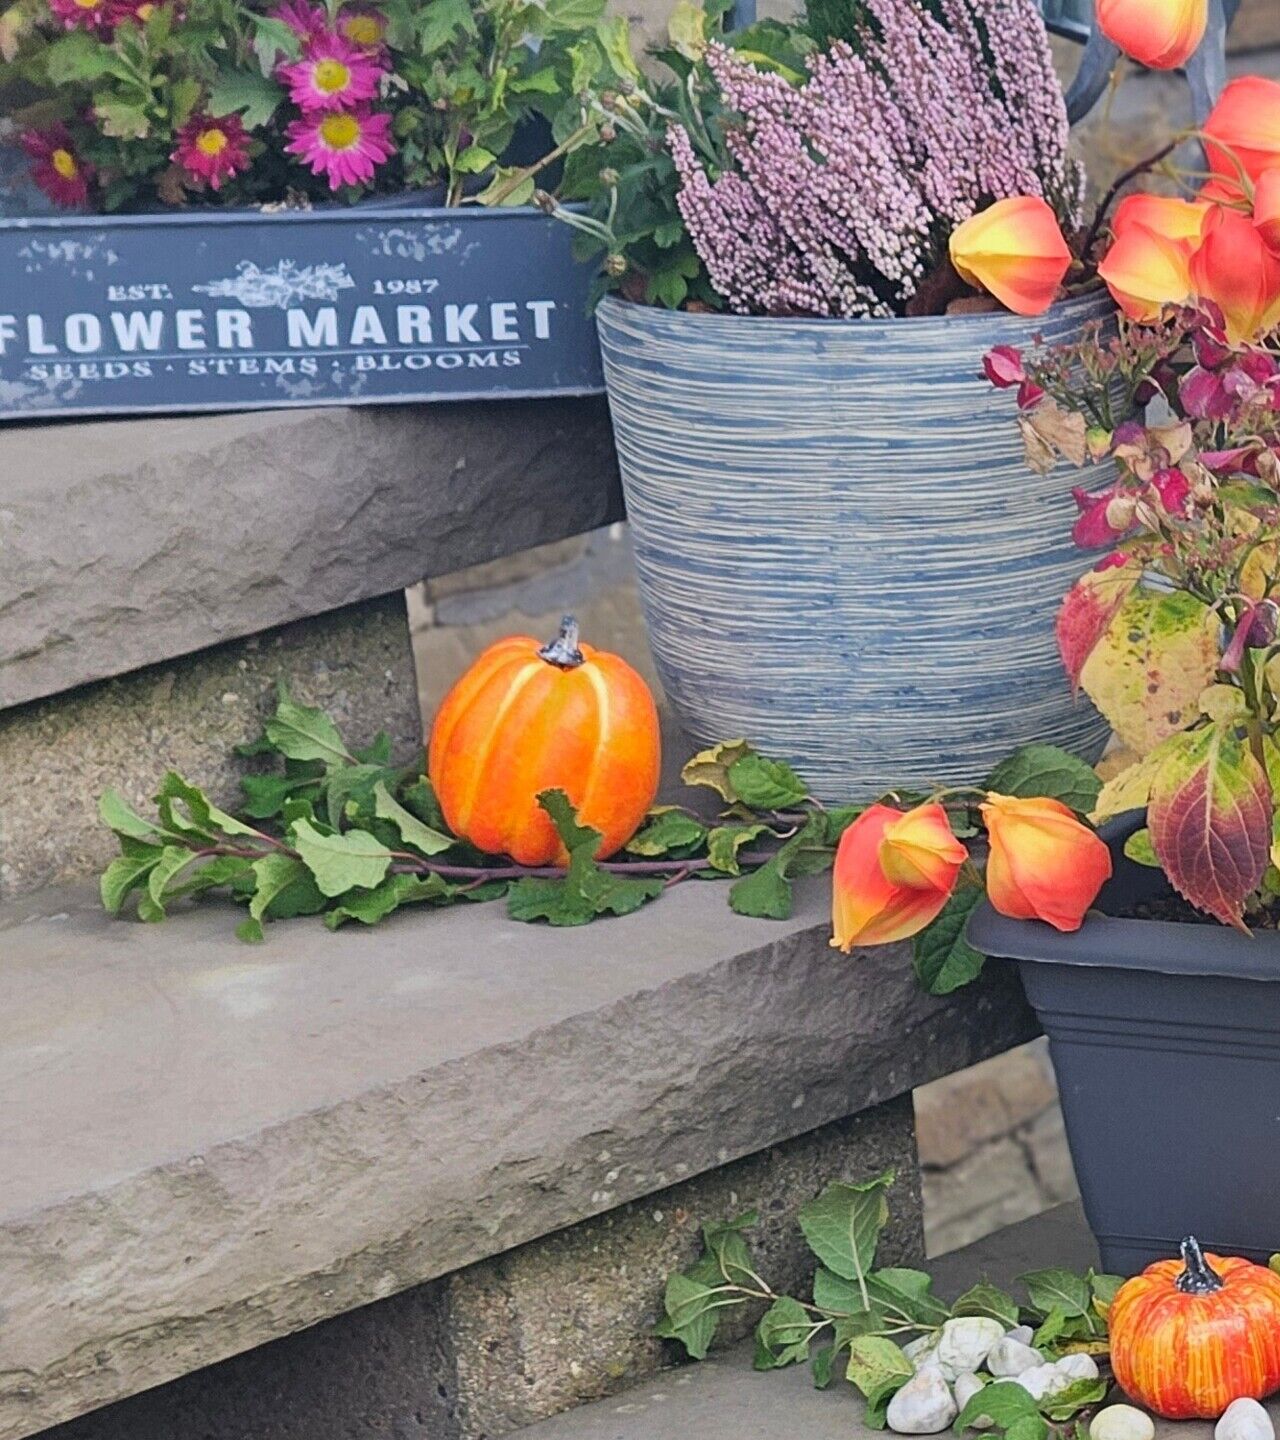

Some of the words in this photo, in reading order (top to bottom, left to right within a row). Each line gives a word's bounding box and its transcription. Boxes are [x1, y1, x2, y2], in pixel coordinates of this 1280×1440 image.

[107, 283, 174, 301] EST.
[373, 278, 440, 295] 1987
[0, 308, 254, 355] FLOWER
[287, 300, 557, 347] MARKET
[28, 361, 153, 381] SEEDS
[188, 357, 319, 377] STEMS
[356, 350, 522, 371] BLOOMS
